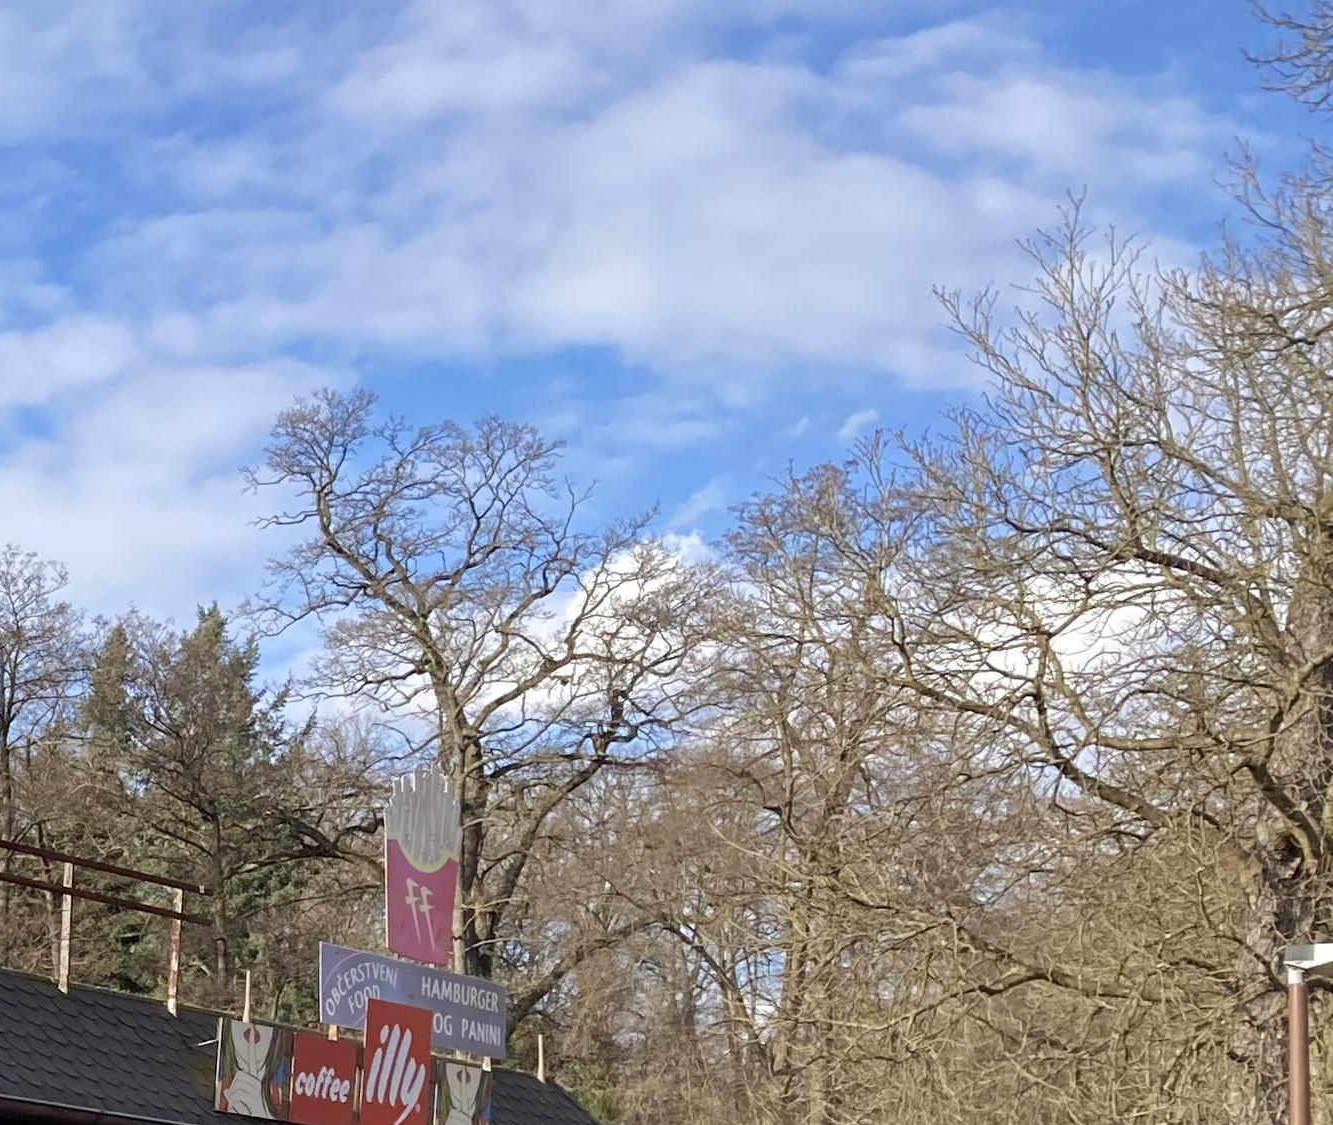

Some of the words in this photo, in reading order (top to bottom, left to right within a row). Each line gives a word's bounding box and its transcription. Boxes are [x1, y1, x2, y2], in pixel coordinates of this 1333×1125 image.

[325, 961, 399, 1017] OBČERSTVENÍ
[421, 975, 499, 1013] HAMBURGER
[433, 1012, 453, 1036] OG
[461, 1018, 502, 1047] PANINI
[294, 1065, 351, 1105] coffee
